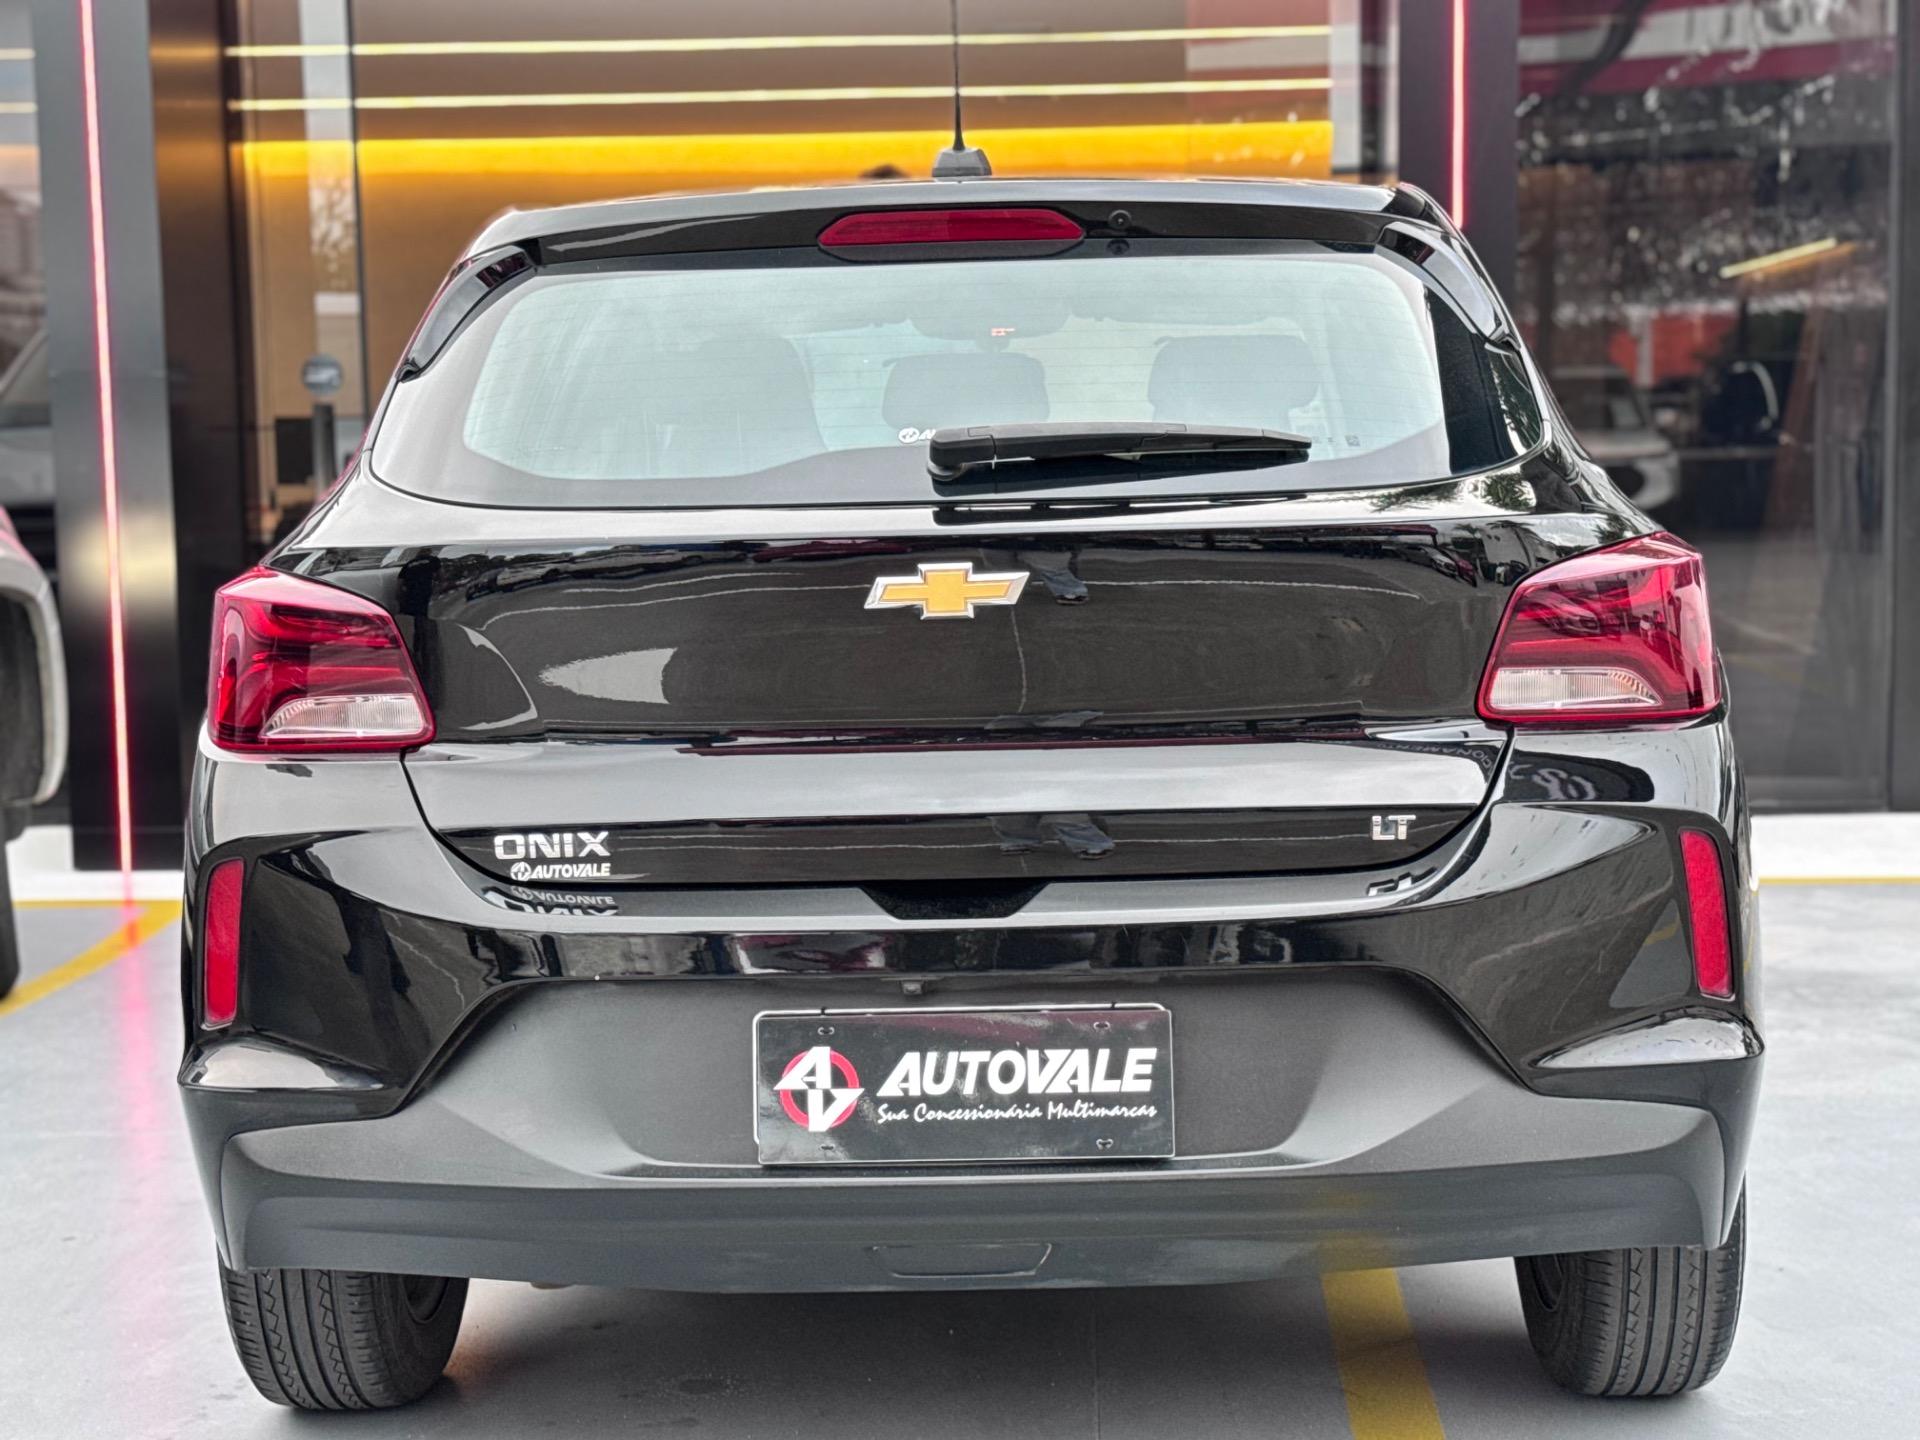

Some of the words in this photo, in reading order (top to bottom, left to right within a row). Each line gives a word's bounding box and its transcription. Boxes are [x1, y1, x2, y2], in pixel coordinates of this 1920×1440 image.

[1371, 814, 1416, 840] LT
[494, 831, 611, 859] ONIX
[530, 863, 611, 880] AUTOVALE
[876, 1047, 1158, 1097] AUTOVALE
[877, 1104, 908, 1125] Sua
[914, 1102, 1043, 1121] Concessionária
[1048, 1099, 1158, 1120] Multimarcas
